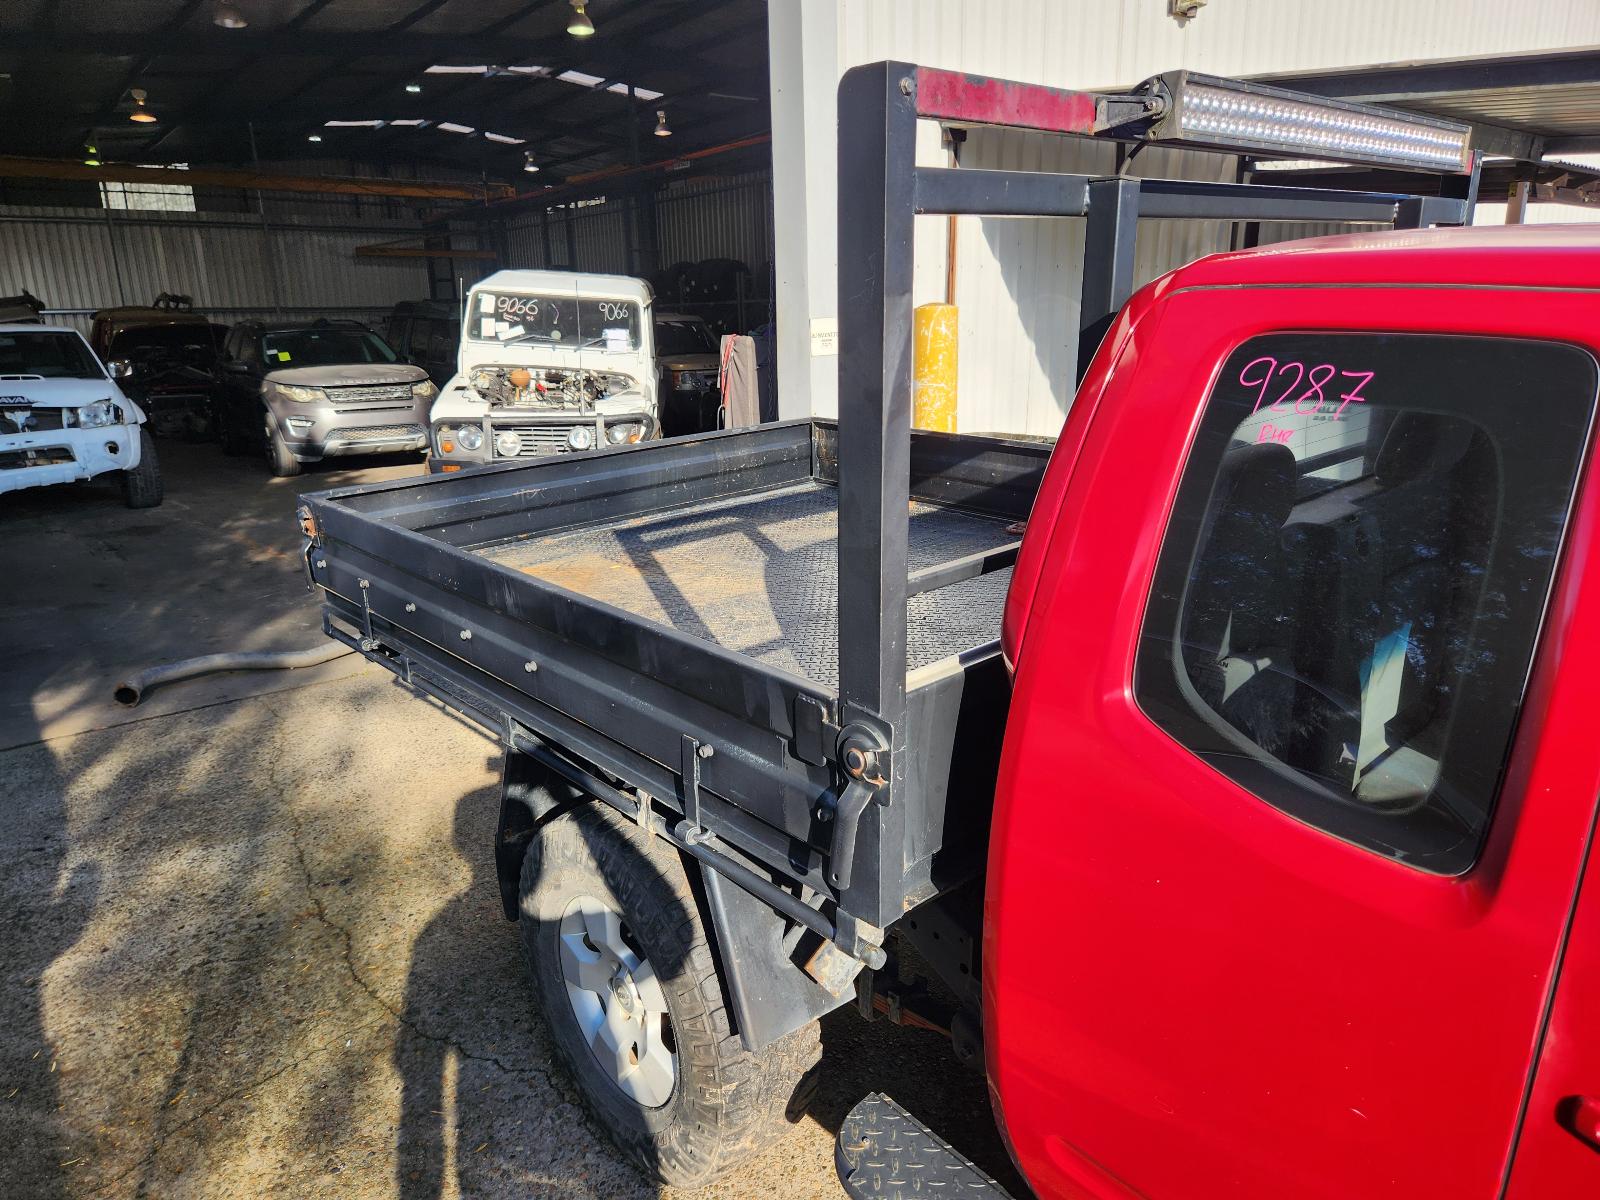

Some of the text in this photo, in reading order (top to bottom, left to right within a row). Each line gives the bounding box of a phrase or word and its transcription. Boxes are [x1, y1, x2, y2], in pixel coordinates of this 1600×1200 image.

[497, 296, 539, 315] 9066
[599, 302, 629, 322] 9066
[1239, 358, 1375, 419] 9287
